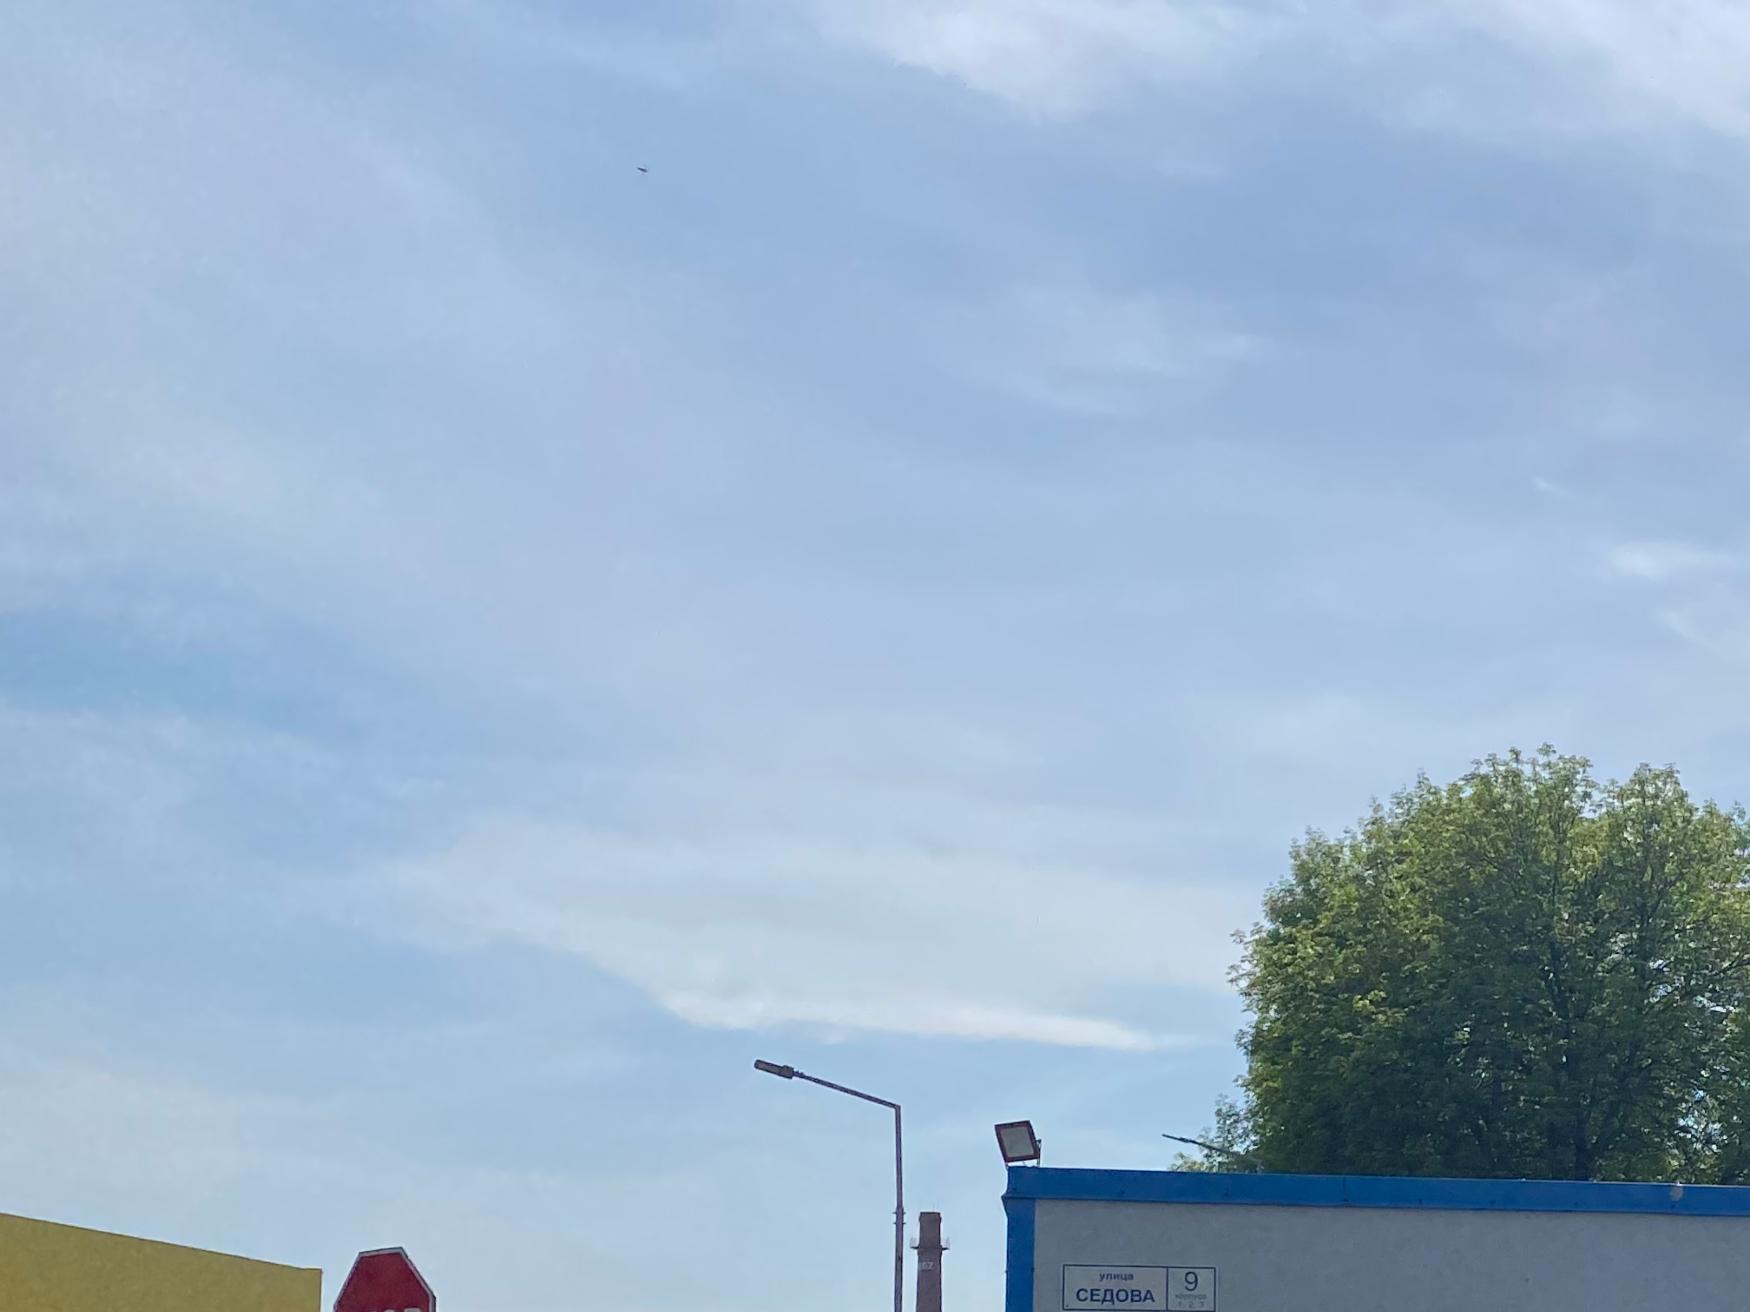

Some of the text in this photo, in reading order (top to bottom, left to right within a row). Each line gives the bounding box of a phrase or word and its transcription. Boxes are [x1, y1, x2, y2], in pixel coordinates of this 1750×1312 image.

[1099, 1272, 1134, 1282] улица
[1184, 1271, 1199, 1292] 9
[1076, 1288, 1156, 1306] СЕДОВА
